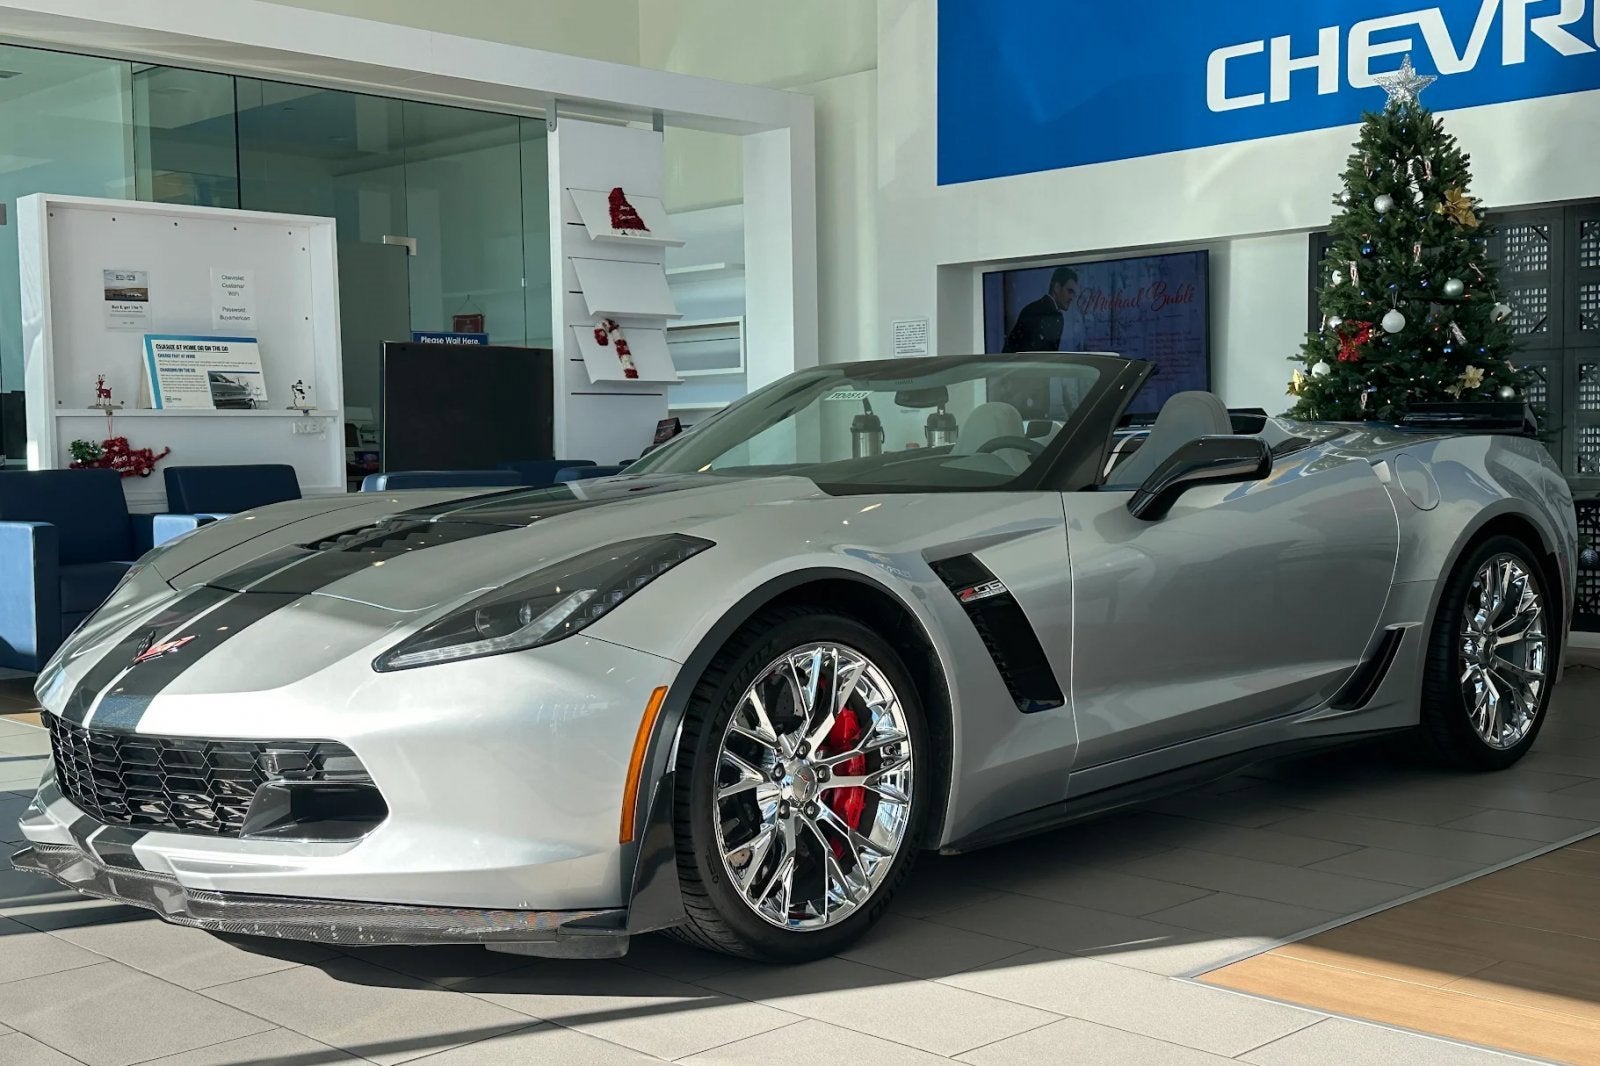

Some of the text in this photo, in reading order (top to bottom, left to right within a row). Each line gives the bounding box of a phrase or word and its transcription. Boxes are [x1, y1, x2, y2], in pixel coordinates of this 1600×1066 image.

[1206, 0, 1600, 113] CHEVR
[420, 335, 481, 345] Please Wait Here.
